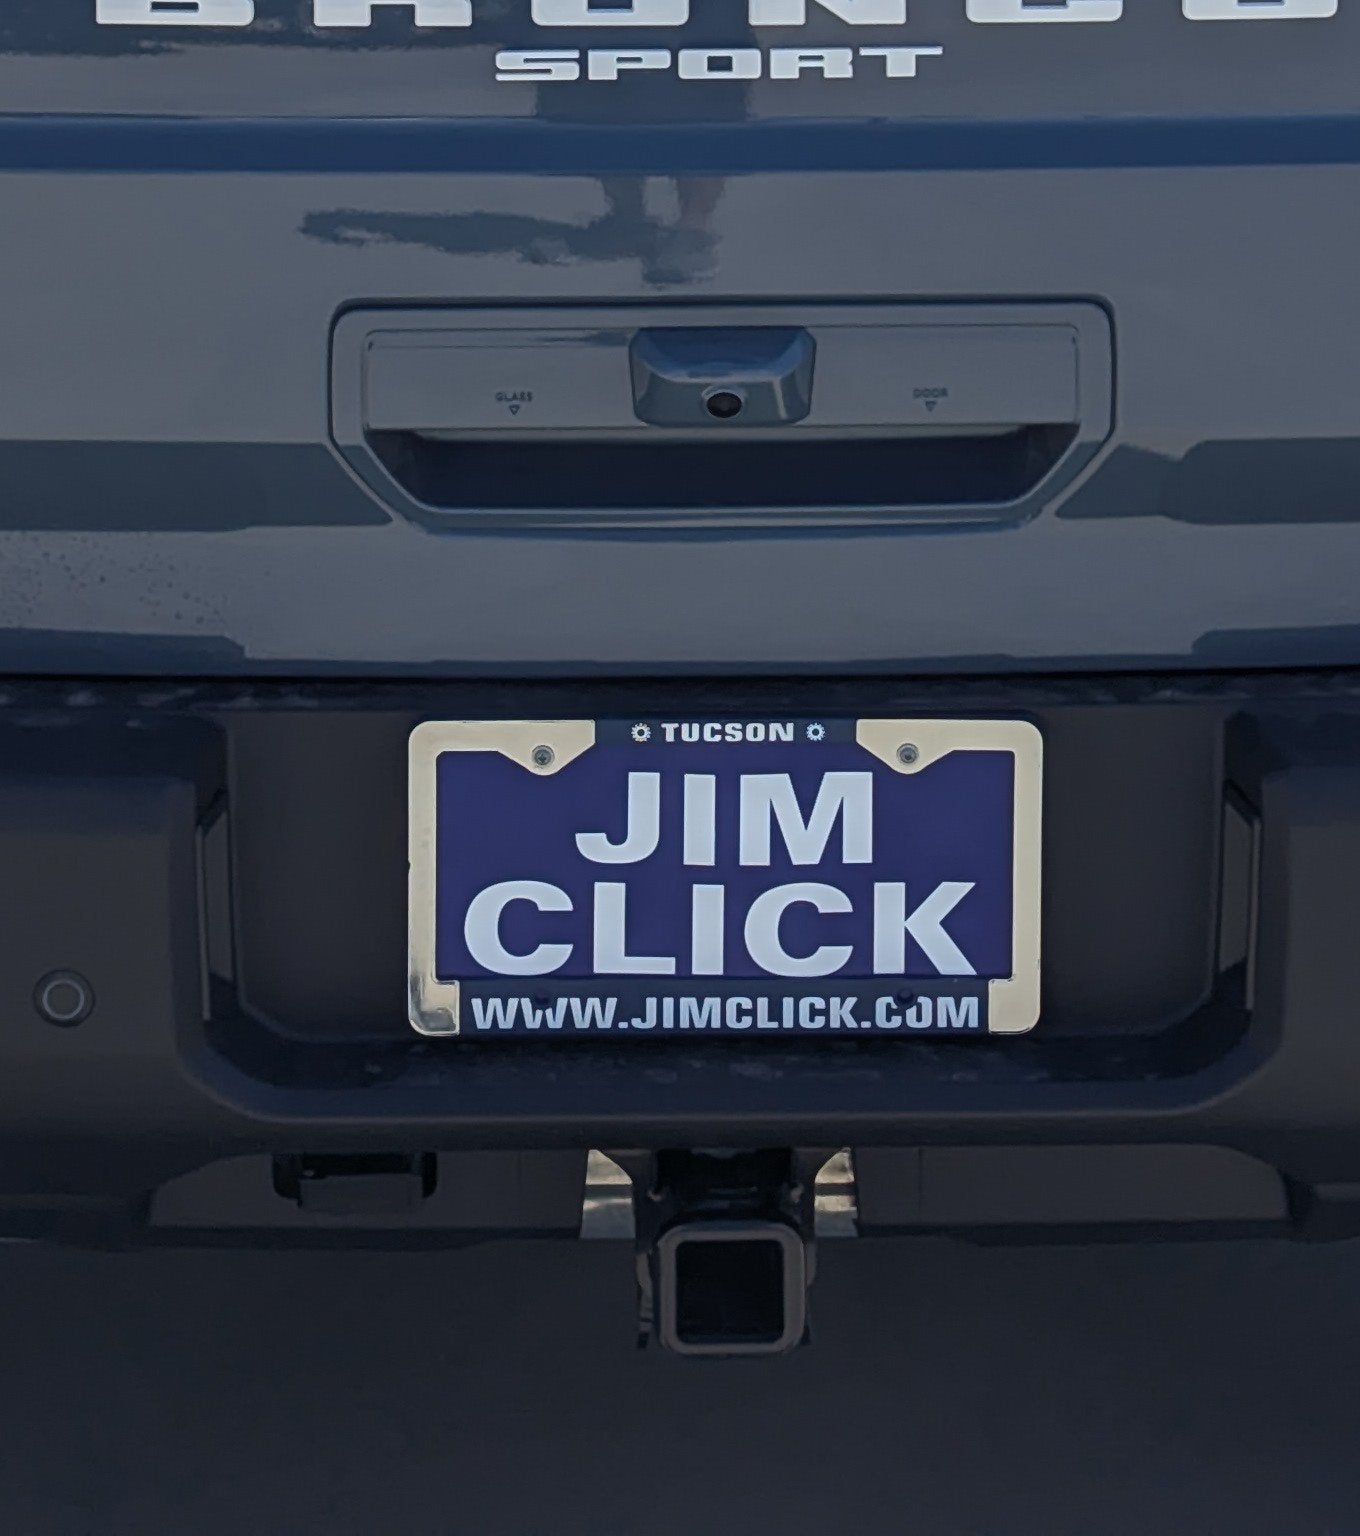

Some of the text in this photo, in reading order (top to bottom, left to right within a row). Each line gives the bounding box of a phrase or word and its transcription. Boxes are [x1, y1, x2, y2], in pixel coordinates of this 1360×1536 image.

[495, 46, 943, 81] SPORT
[660, 722, 795, 743] TUCSON
[575, 771, 873, 866] JIM
[464, 880, 978, 977] CLICK
[471, 995, 979, 1031] WWW.JIMCLICK.COM
